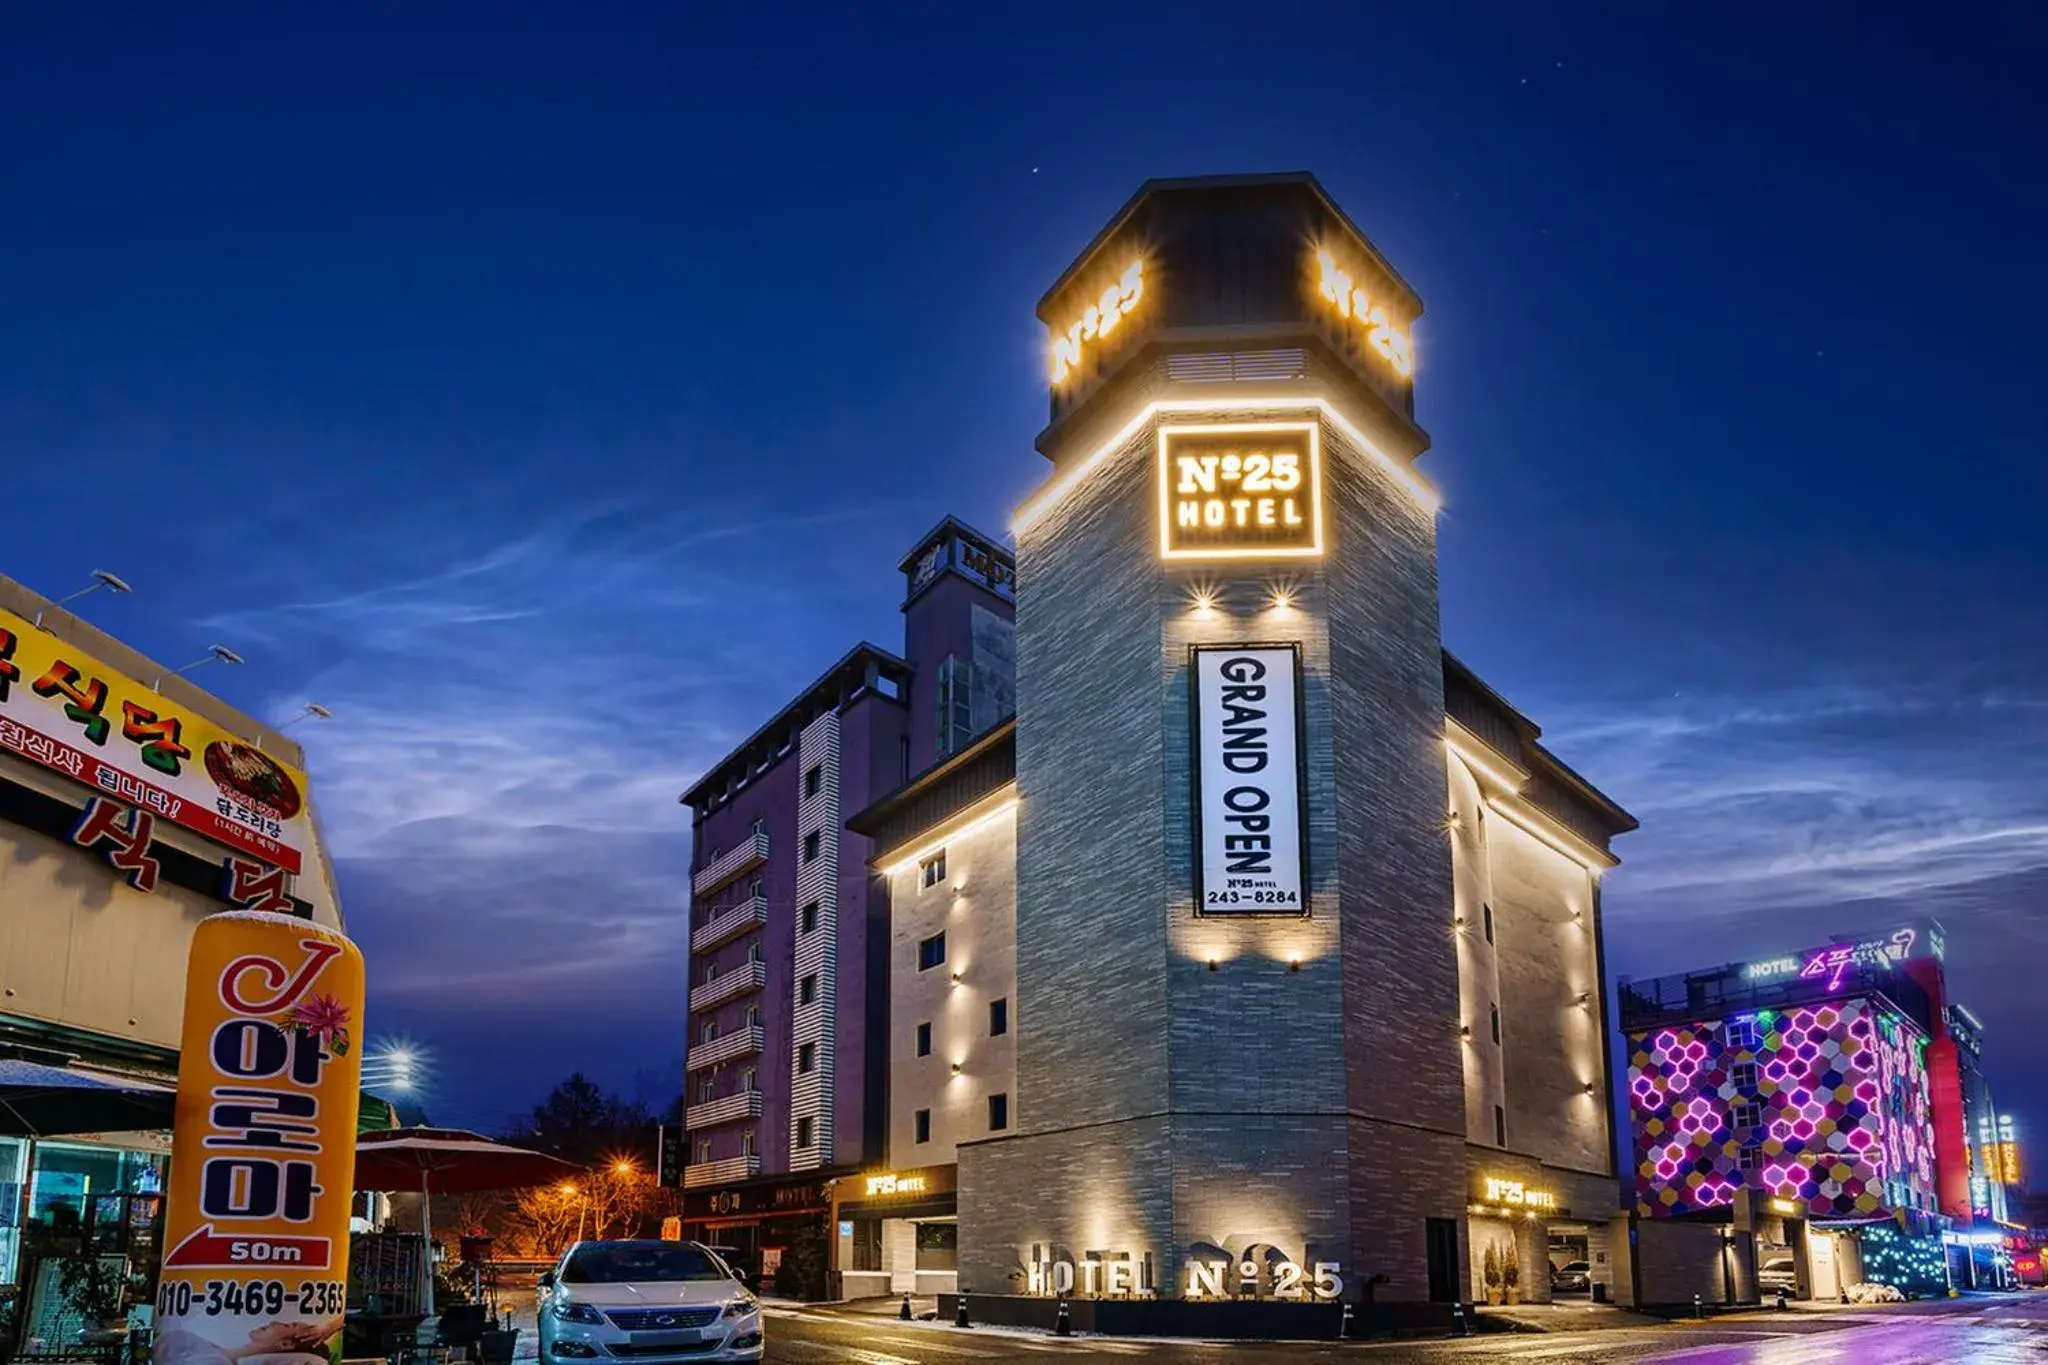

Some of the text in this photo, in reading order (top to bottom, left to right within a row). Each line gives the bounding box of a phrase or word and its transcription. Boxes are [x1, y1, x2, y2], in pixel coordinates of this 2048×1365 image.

[1178, 499, 1301, 528] HOTEL
[1220, 657, 1272, 874] GRAND OPEN
[95, 763, 182, 819] 됩니다!
[1208, 891, 1297, 903] 243-8284
[1750, 959, 1798, 978] HOTEL
[200, 1019, 331, 1223] 아로마
[230, 1241, 301, 1261] 50m
[1027, 1260, 1153, 1296] HOTEL
[158, 1279, 344, 1316] 010-3469-2365
